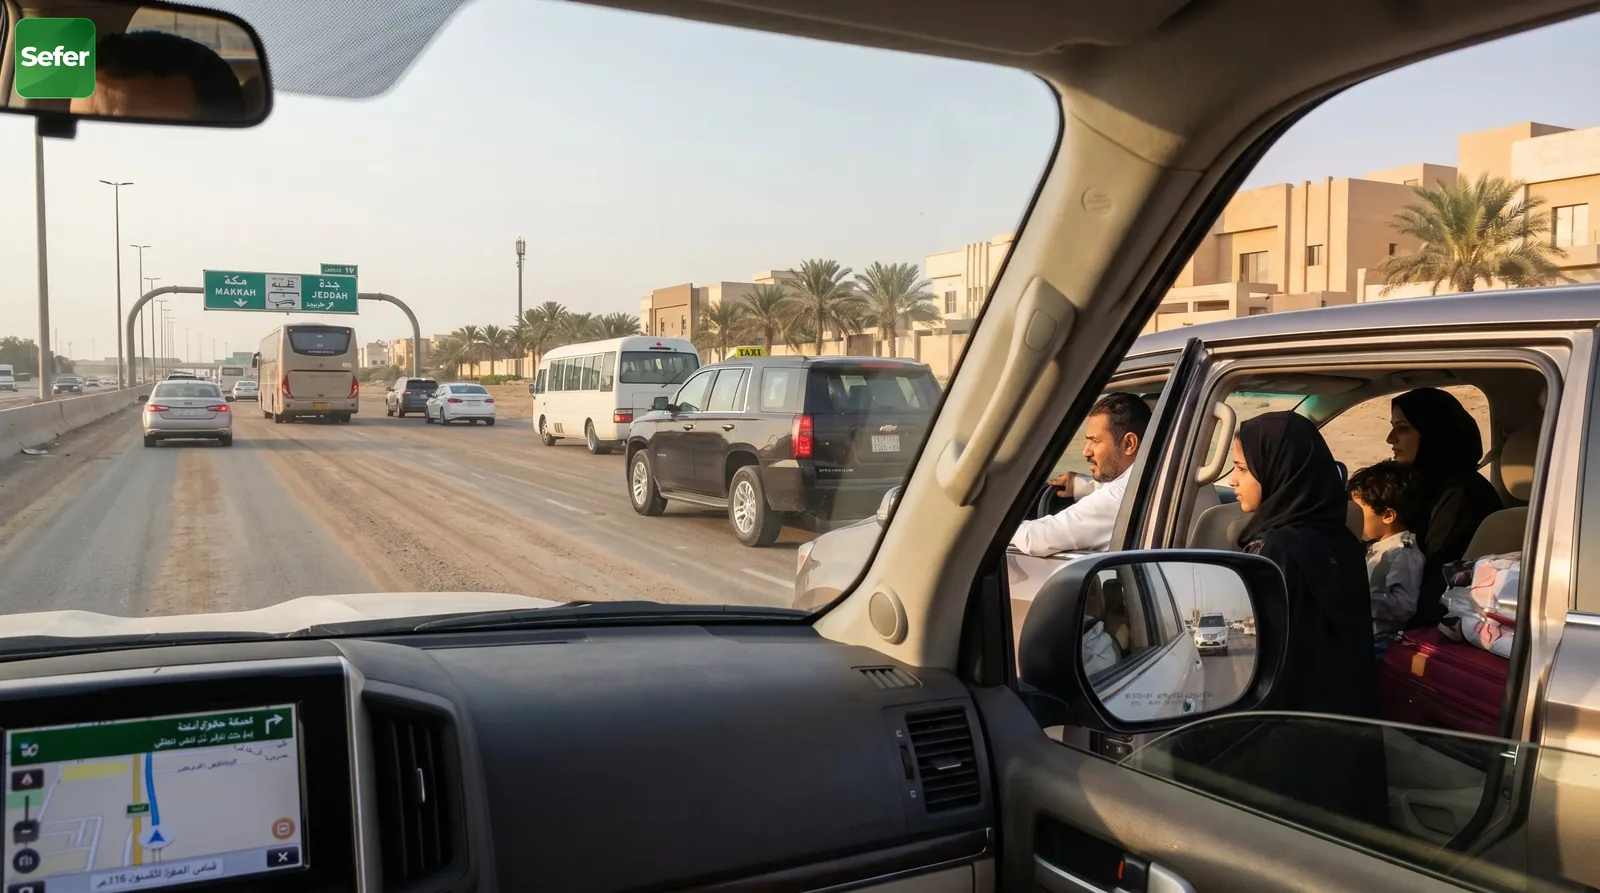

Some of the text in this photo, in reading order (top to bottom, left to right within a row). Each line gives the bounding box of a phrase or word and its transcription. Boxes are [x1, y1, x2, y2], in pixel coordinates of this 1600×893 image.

[224, 275, 247, 285] مكة
[319, 279, 340, 290] جدة
[215, 287, 256, 296] MAKKAH
[312, 291, 348, 299] JEDDAH
